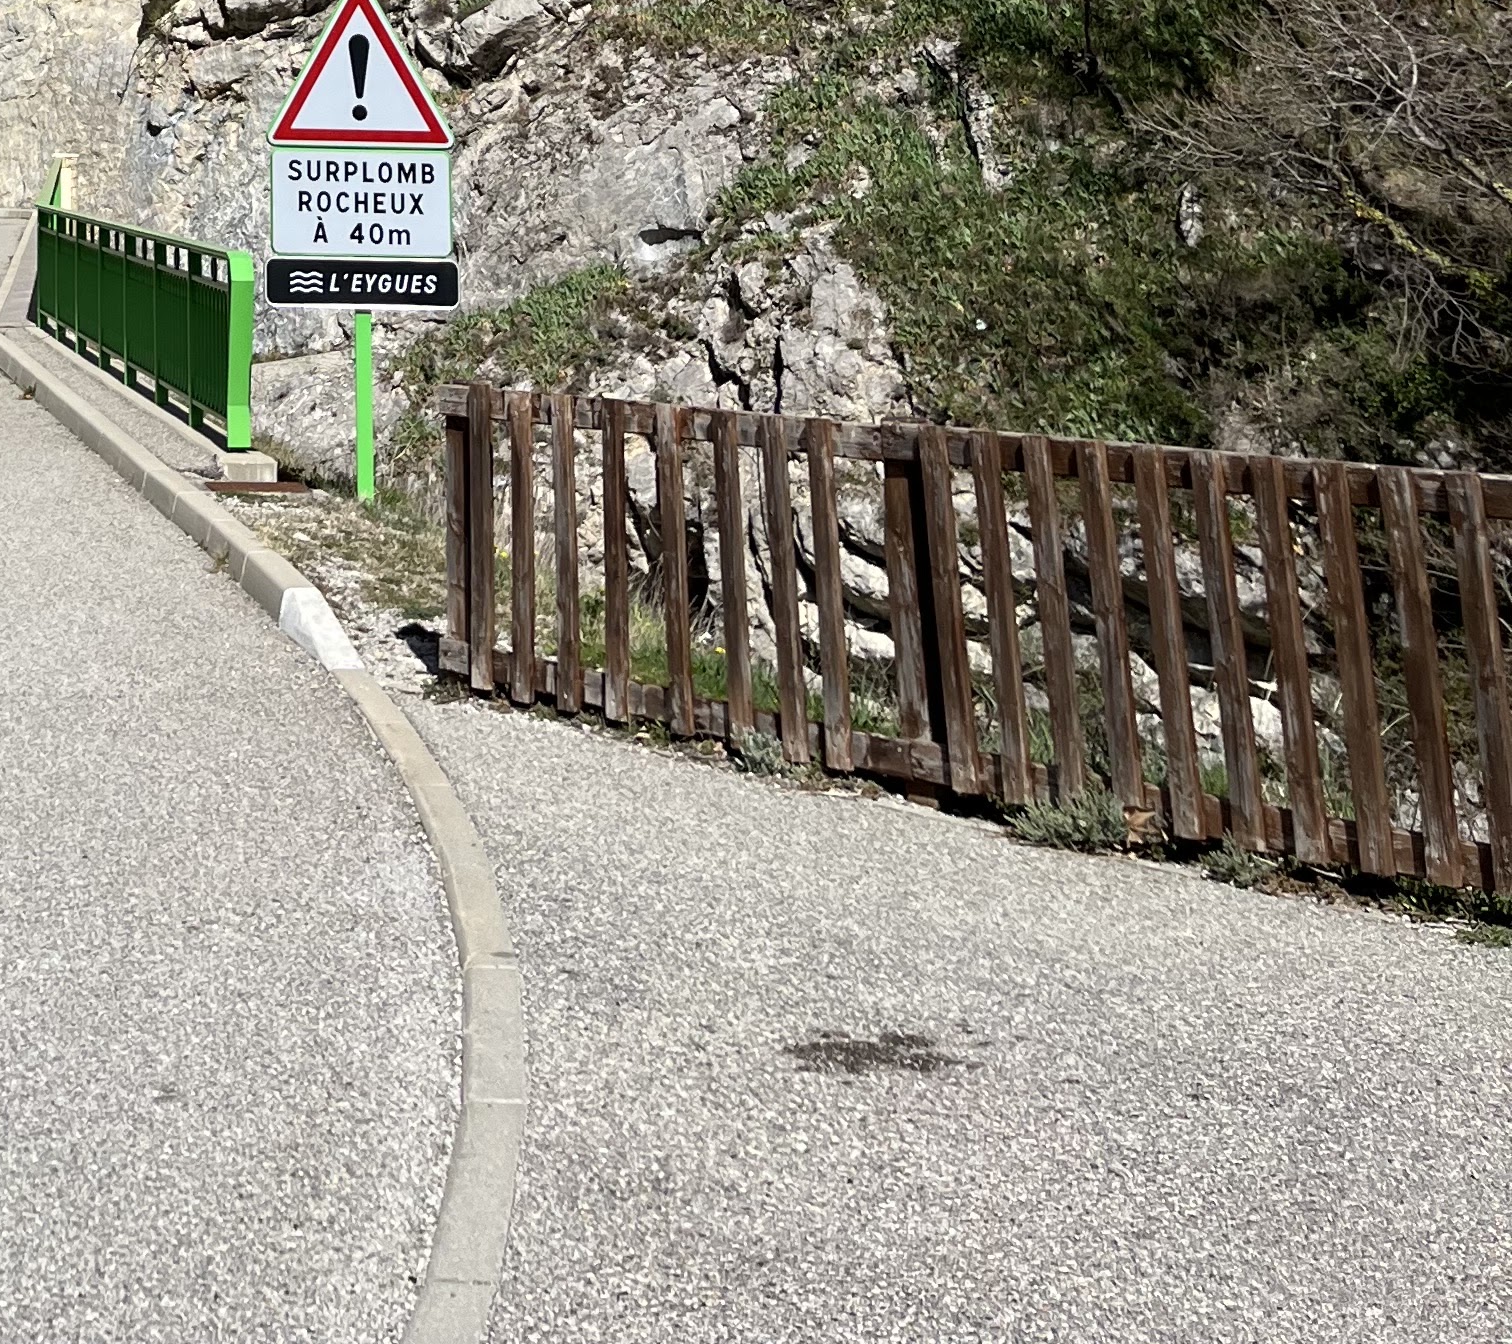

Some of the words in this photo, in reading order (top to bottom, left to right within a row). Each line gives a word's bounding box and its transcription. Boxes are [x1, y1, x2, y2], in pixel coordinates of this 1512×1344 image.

[288, 159, 435, 184] SURPLOMB
[298, 190, 424, 215] ROCHEUX
[313, 216, 328, 243] À
[349, 222, 411, 245] 40m
[329, 273, 438, 294] L'EYGUES
